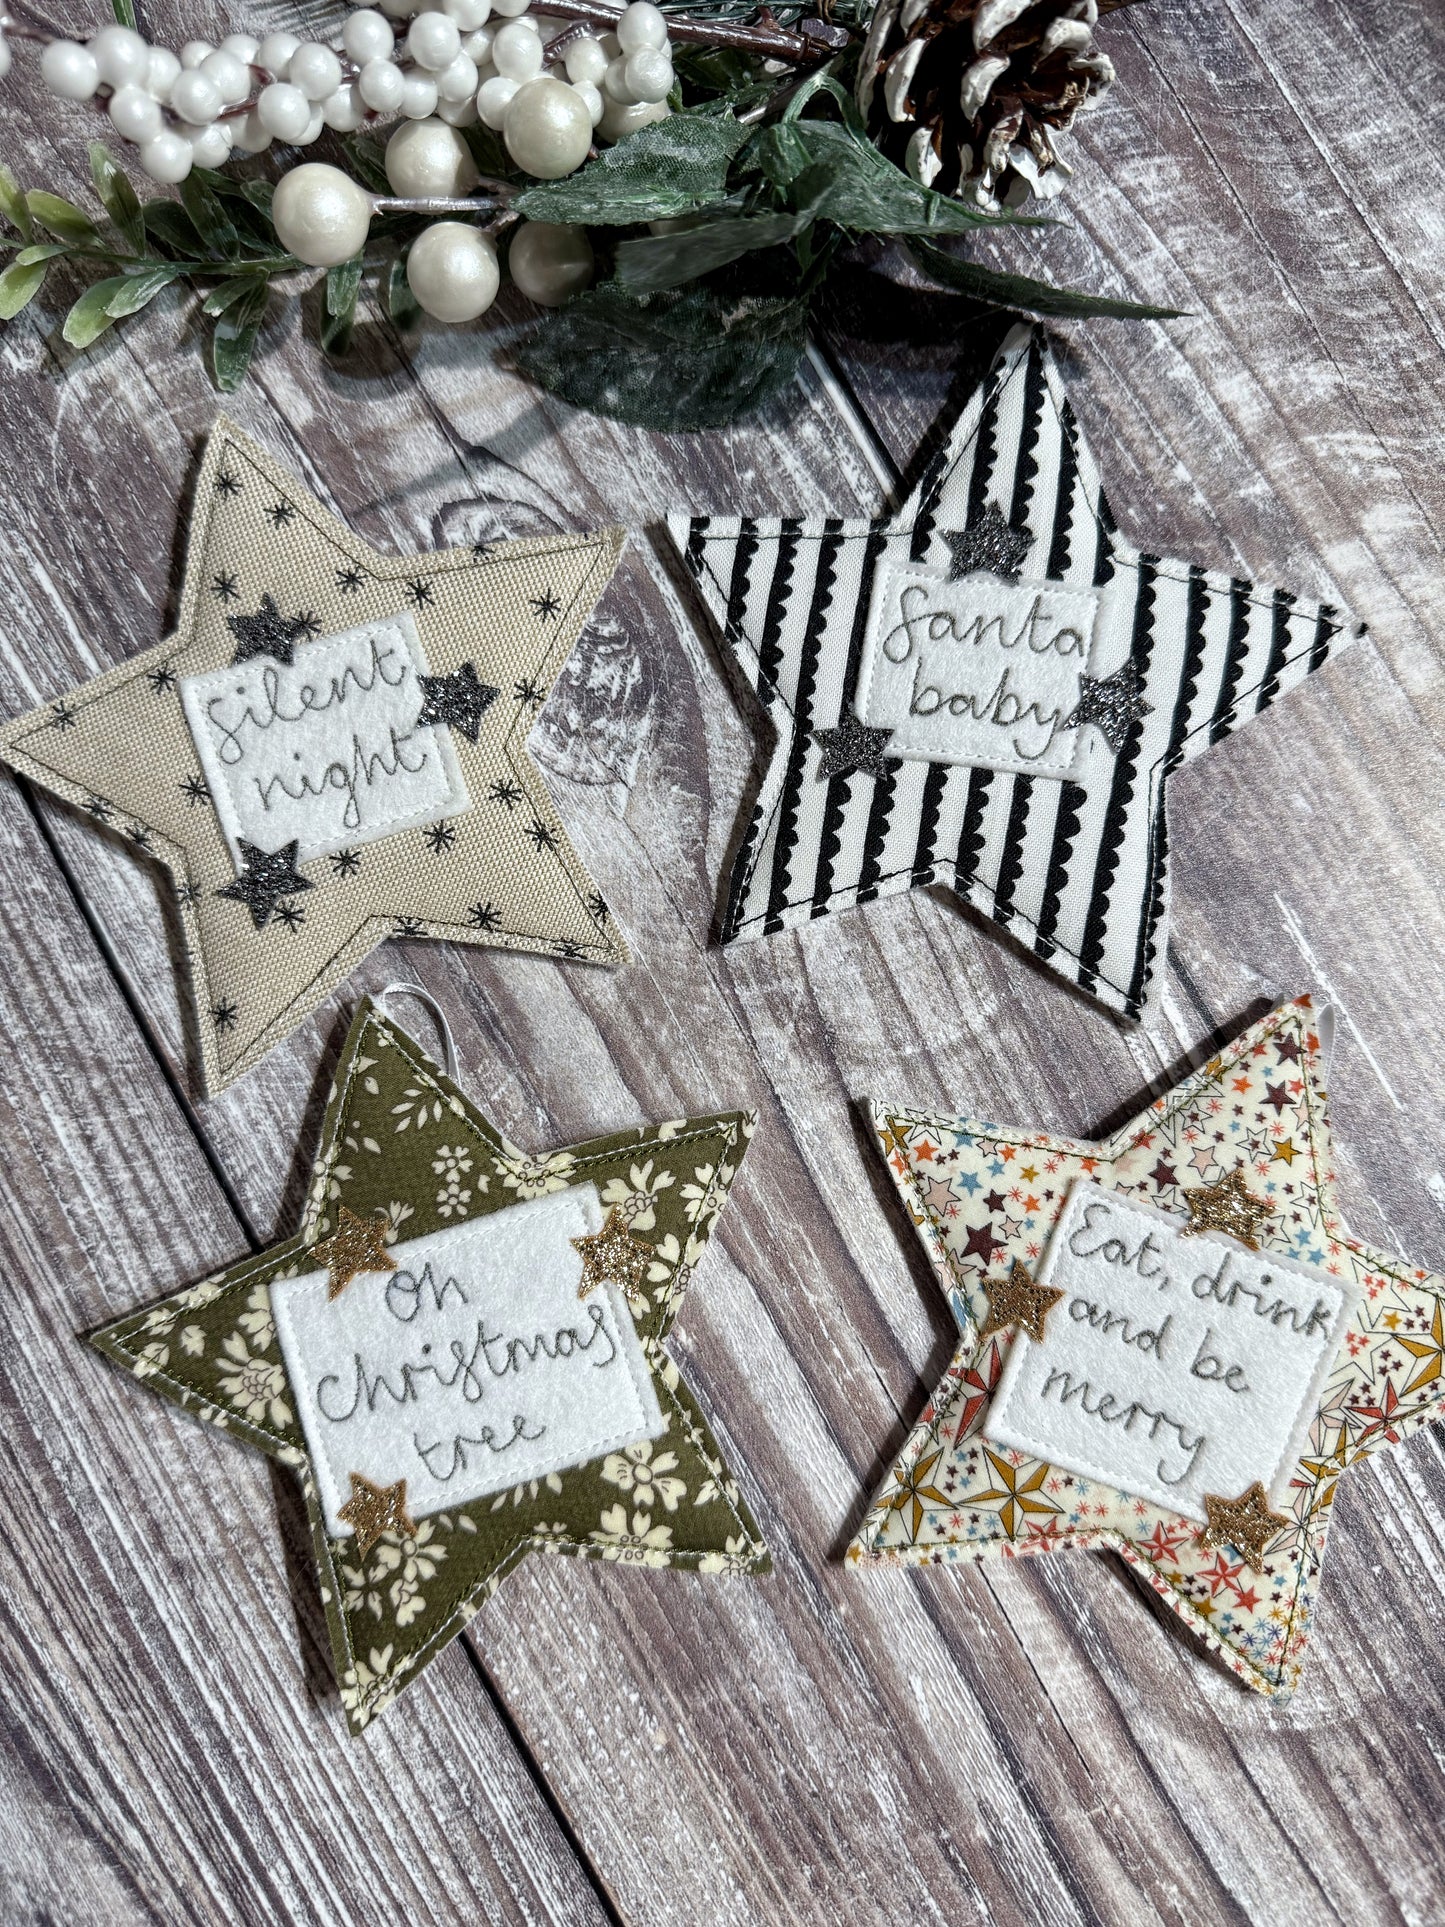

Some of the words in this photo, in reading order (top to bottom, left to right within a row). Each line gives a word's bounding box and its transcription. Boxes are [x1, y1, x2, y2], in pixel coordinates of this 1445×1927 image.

[882, 585, 1084, 664] Santa
[909, 656, 1060, 760] baby
[254, 727, 428, 829] night
[385, 1261, 468, 1322] Oh
[1069, 1203, 1169, 1291] Eat,
[1191, 1252, 1332, 1340] drink
[1068, 1299, 1172, 1360] and
[1190, 1327, 1249, 1393] be
[413, 1415, 546, 1481] tree
[1041, 1366, 1205, 1485] merry
